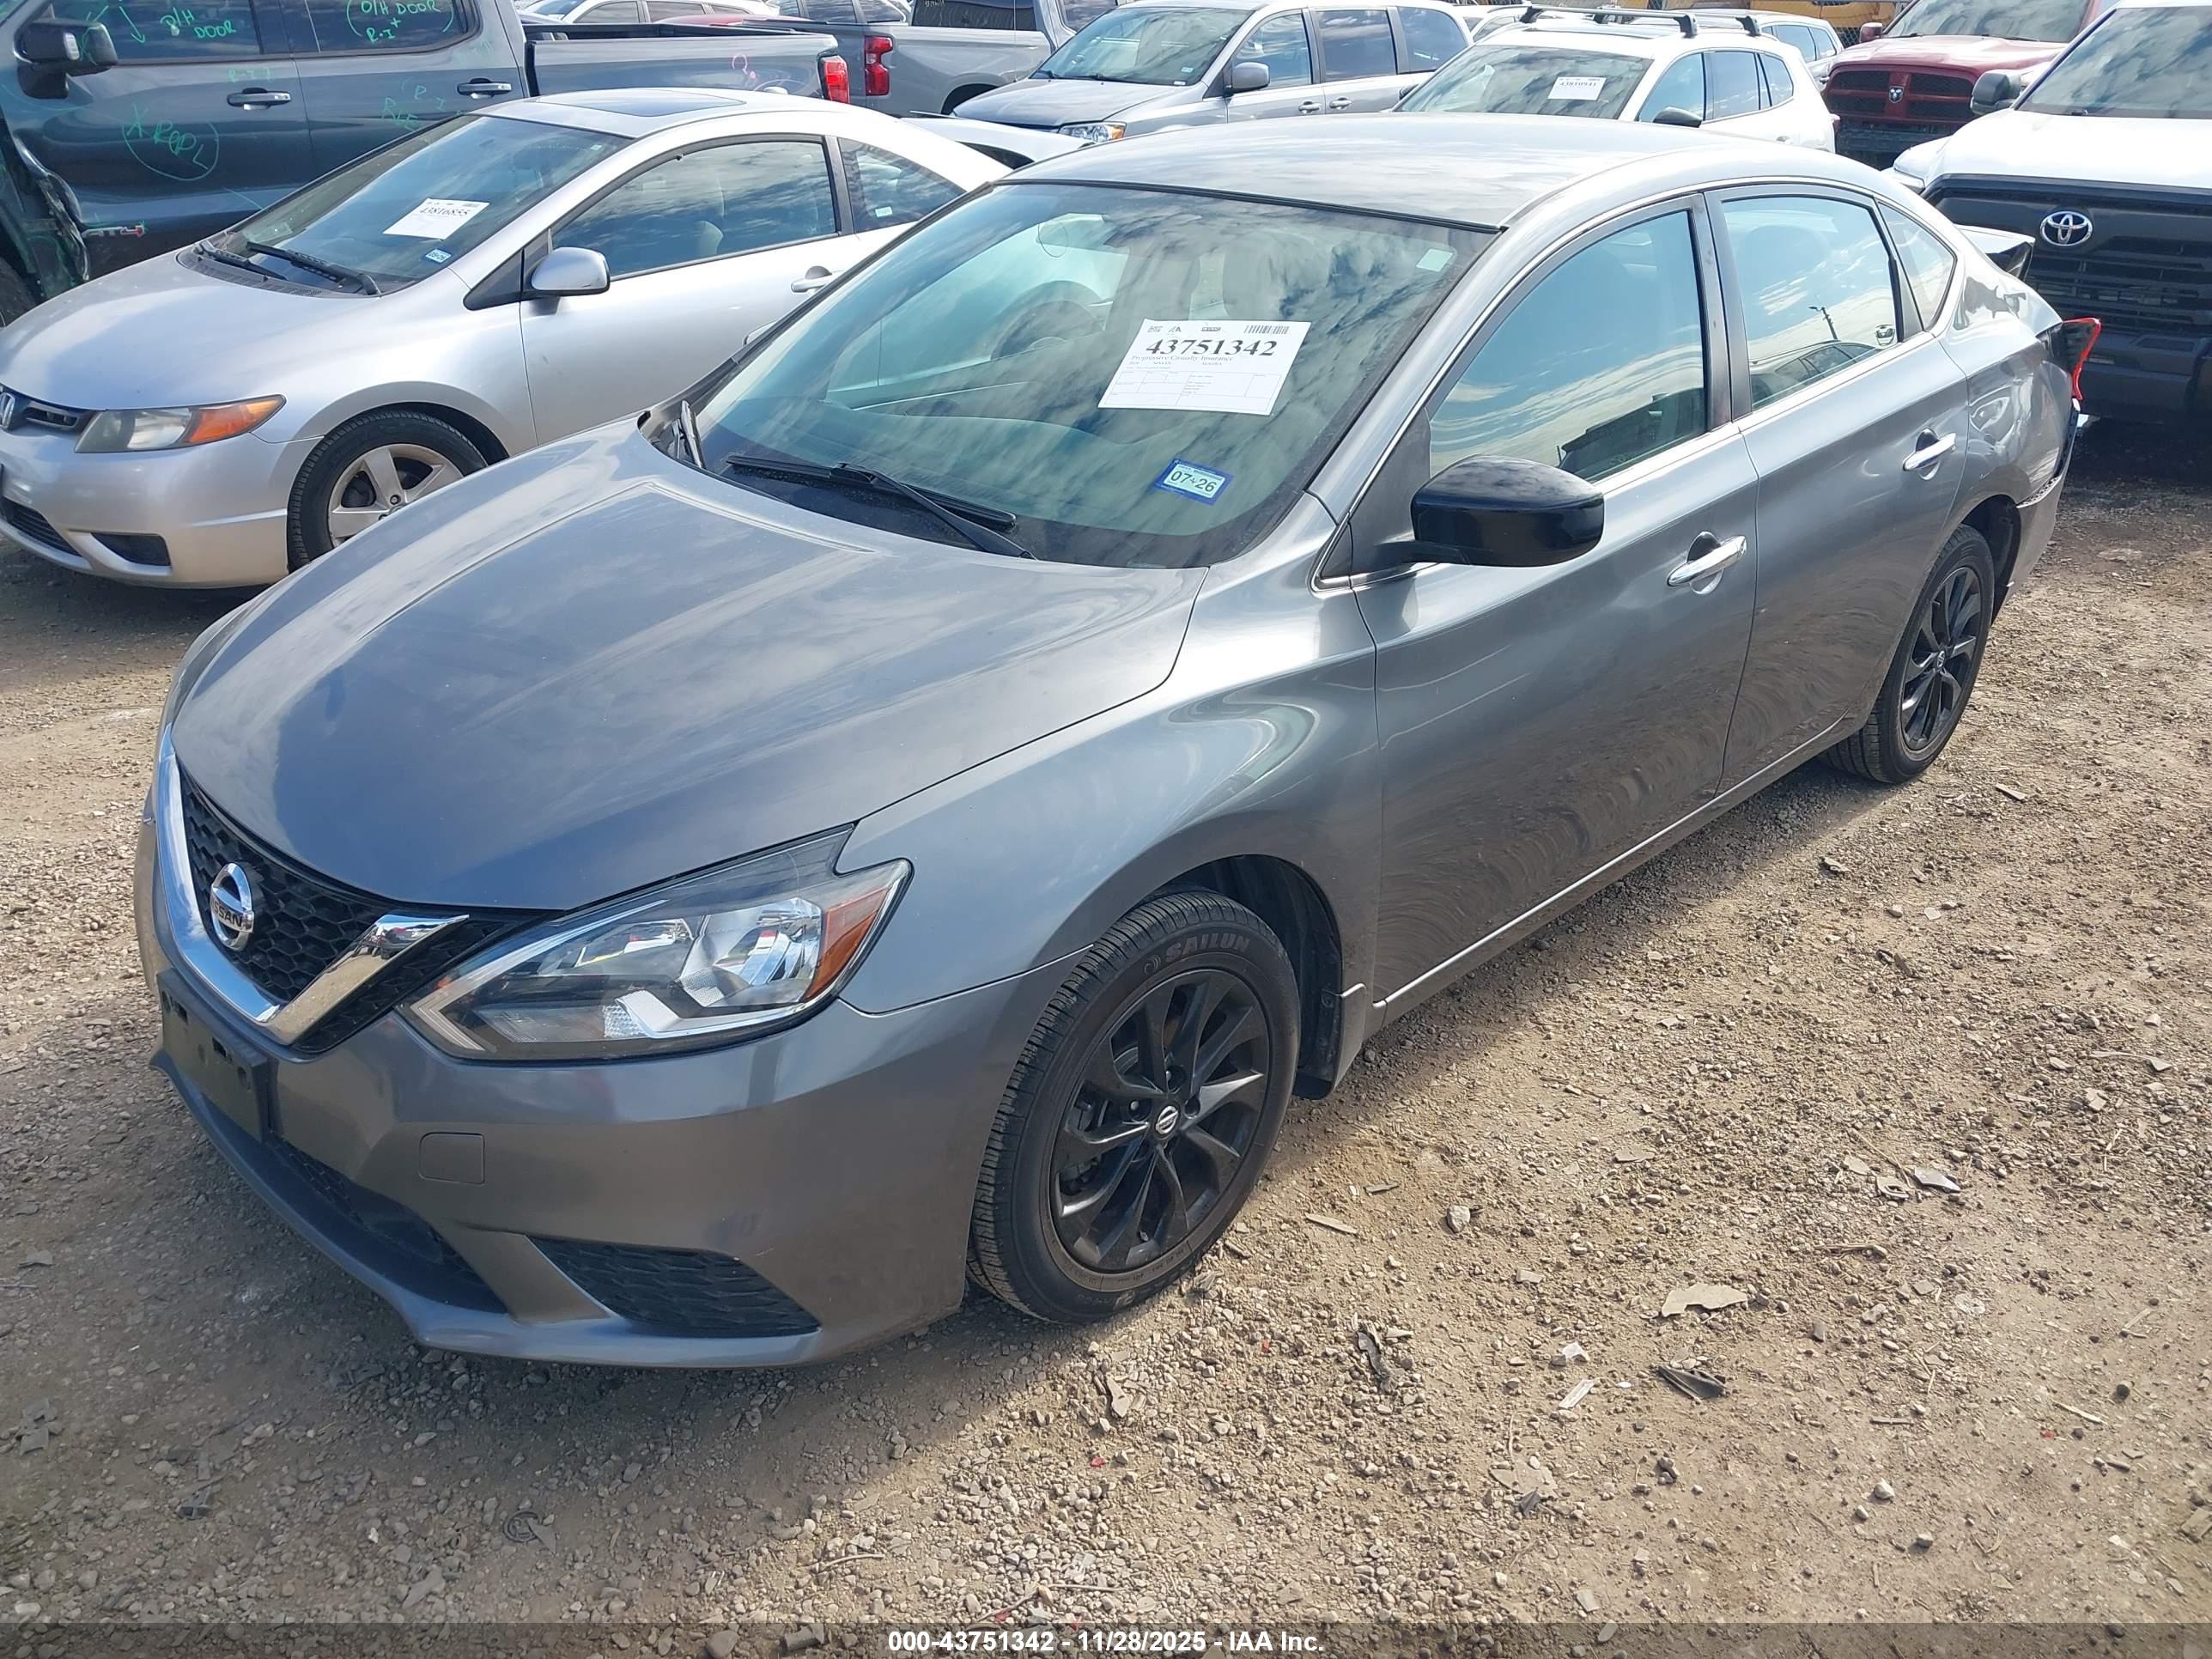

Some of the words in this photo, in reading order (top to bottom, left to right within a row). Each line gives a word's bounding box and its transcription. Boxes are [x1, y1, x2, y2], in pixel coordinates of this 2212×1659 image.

[193, 20, 237, 39] DOOR
[1146, 338, 1278, 356] 43751342
[210, 900, 243, 927] NISSAN
[1164, 933, 1251, 963] SAILUN
